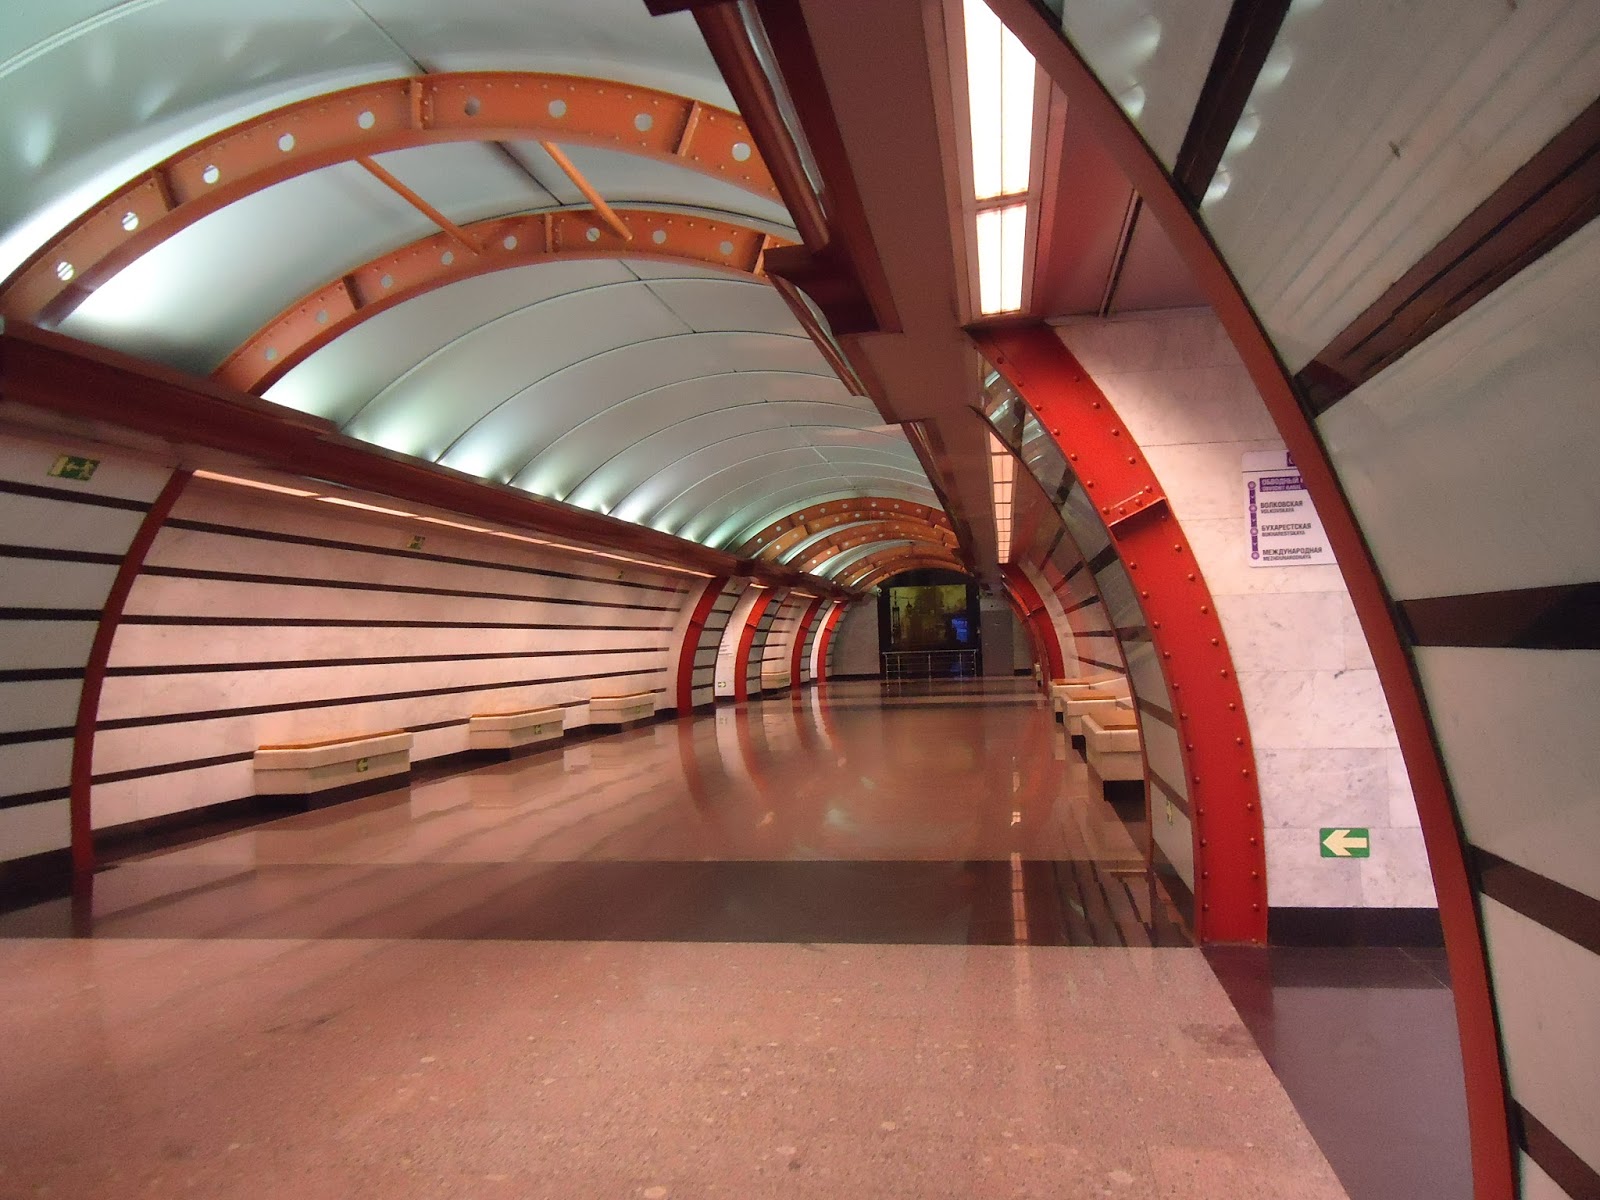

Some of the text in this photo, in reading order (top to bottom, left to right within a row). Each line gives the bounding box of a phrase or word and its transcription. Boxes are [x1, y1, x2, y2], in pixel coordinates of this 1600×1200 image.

[1260, 500, 1303, 509] ВОЛКОВСКАЯ
[1261, 523, 1312, 532] БУХАРЕСТСКАЯ
[1262, 547, 1323, 556] МЕЖДУНАРОДНАЯ
